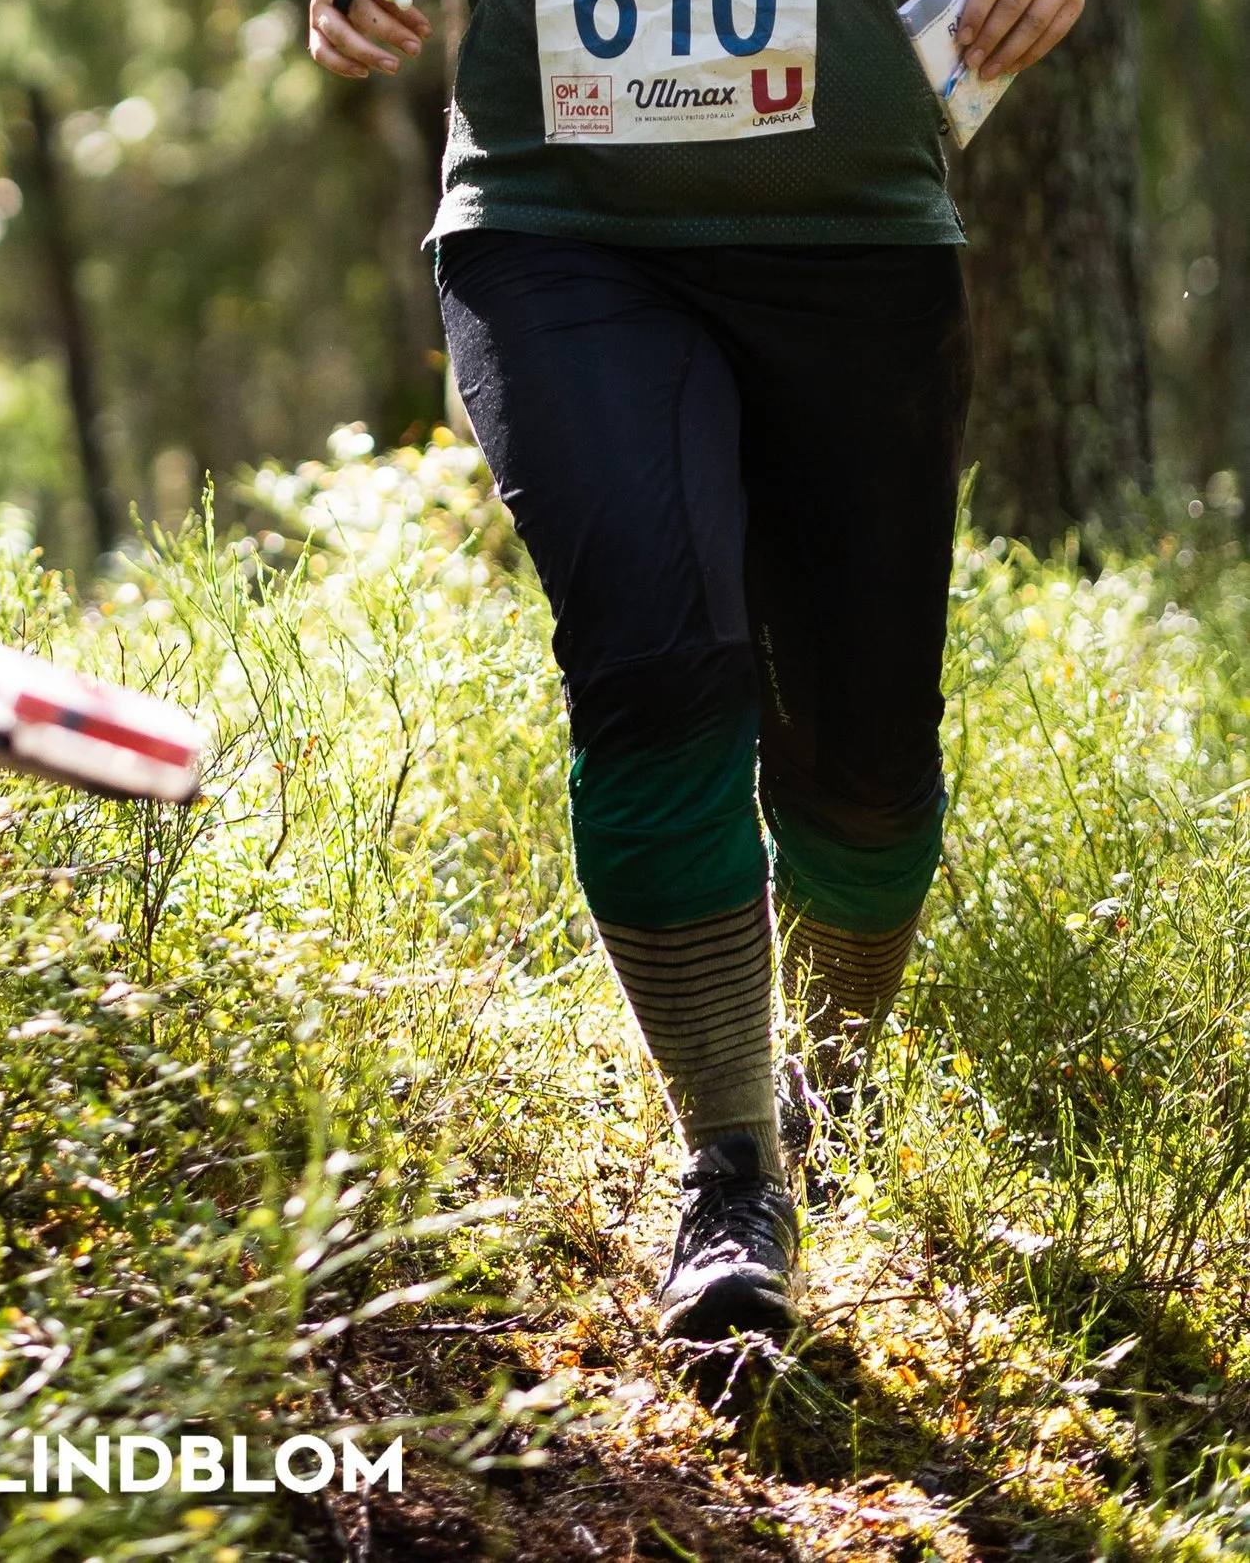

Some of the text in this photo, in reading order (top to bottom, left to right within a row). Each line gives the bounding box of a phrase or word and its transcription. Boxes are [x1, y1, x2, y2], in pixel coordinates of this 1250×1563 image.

[627, 78, 735, 109] Ullmax
[557, 101, 609, 116] Tisaren
[752, 112, 801, 126] UMARA
